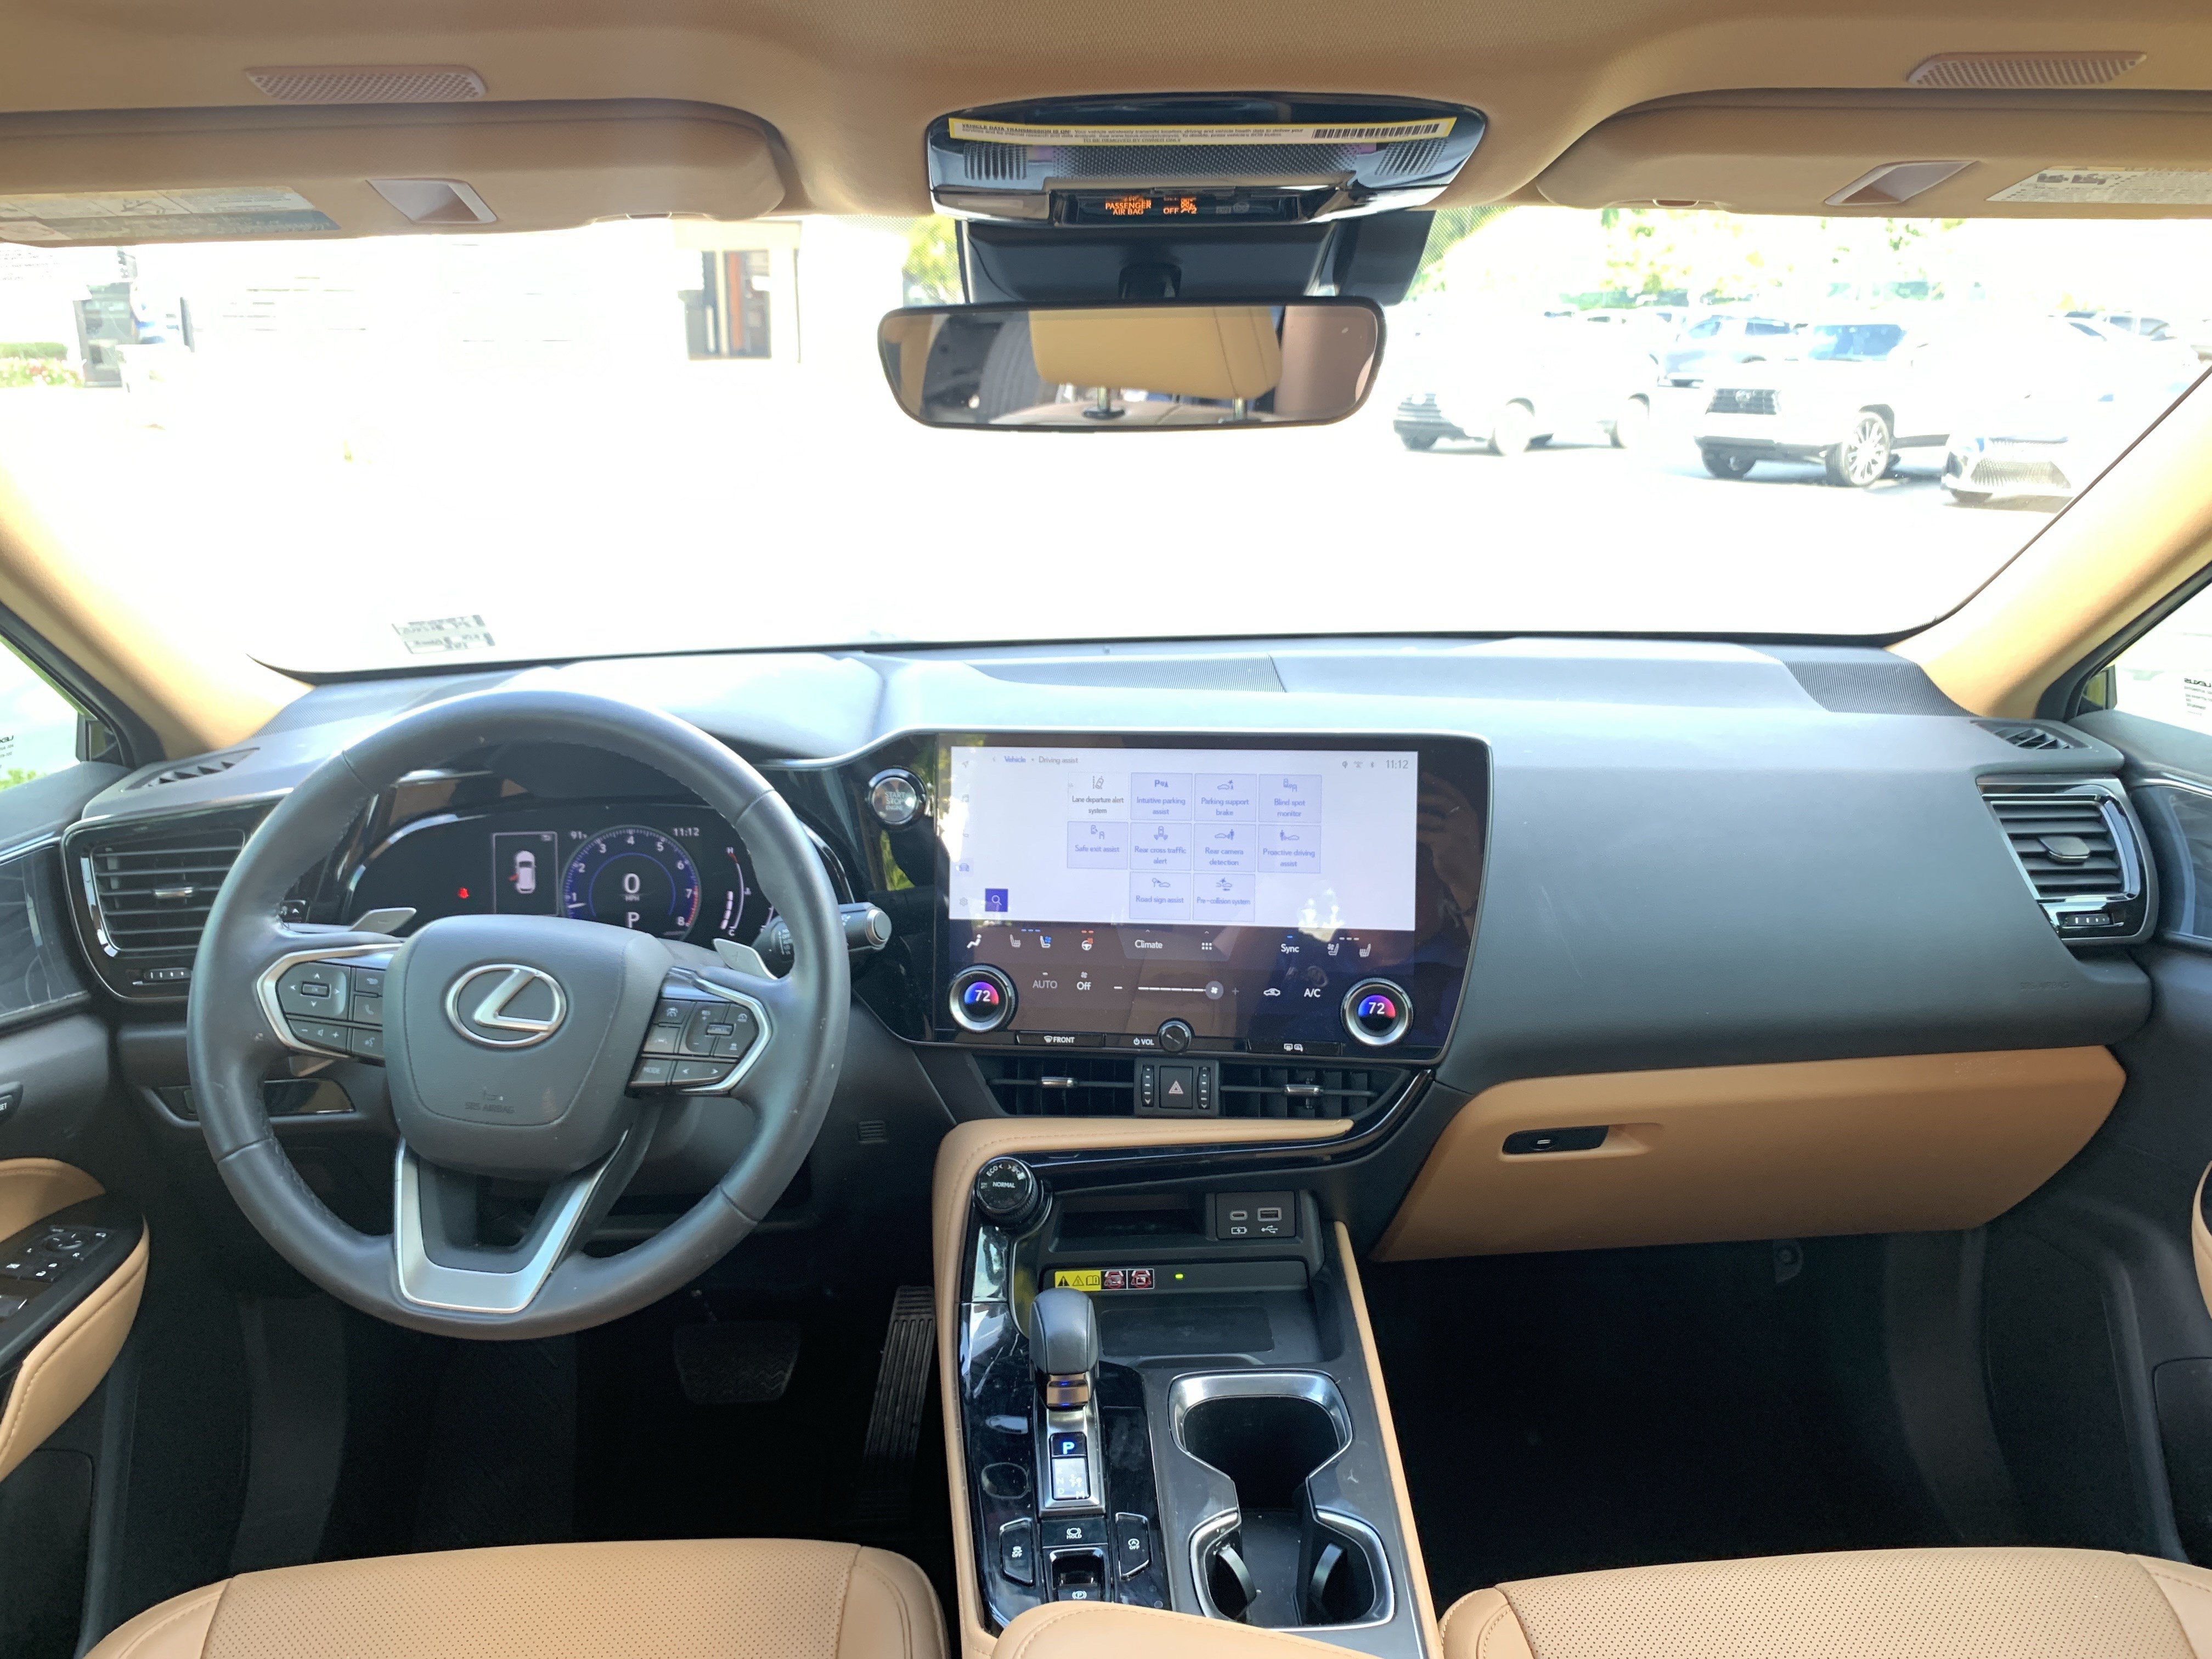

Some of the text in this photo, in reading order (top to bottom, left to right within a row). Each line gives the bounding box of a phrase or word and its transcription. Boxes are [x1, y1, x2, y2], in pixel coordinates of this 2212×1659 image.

[1105, 200, 1151, 210] PASSENGER
[1039, 756, 1060, 765] Driving
[1386, 759, 1409, 769] 11:12
[1163, 797, 1186, 805] parking
[1201, 797, 1224, 806] Parking
[673, 827, 700, 837] 11:12
[627, 836, 635, 845] 4
[599, 844, 607, 854] 3
[656, 842, 664, 852] 5
[1293, 849, 1316, 858] driving
[578, 863, 586, 873] 2
[677, 861, 685, 870] 6
[624, 873, 640, 894] 0
[572, 892, 577, 901] 1
[685, 888, 692, 899] 7
[1136, 895, 1152, 903] Road
[627, 911, 640, 928] P
[677, 916, 685, 926] 8
[1135, 939, 1163, 949] Climate
[1280, 943, 1300, 954] Sync
[1032, 980, 1058, 989] AUTO
[1076, 981, 1091, 991] Off
[974, 990, 991, 1002] 72
[1304, 988, 1321, 998] A/C
[1368, 1002, 1385, 1014] 72
[483, 1104, 515, 1114] AIRBAG
[986, 1165, 998, 1177] ECO
[1063, 1442, 1075, 1454] P
